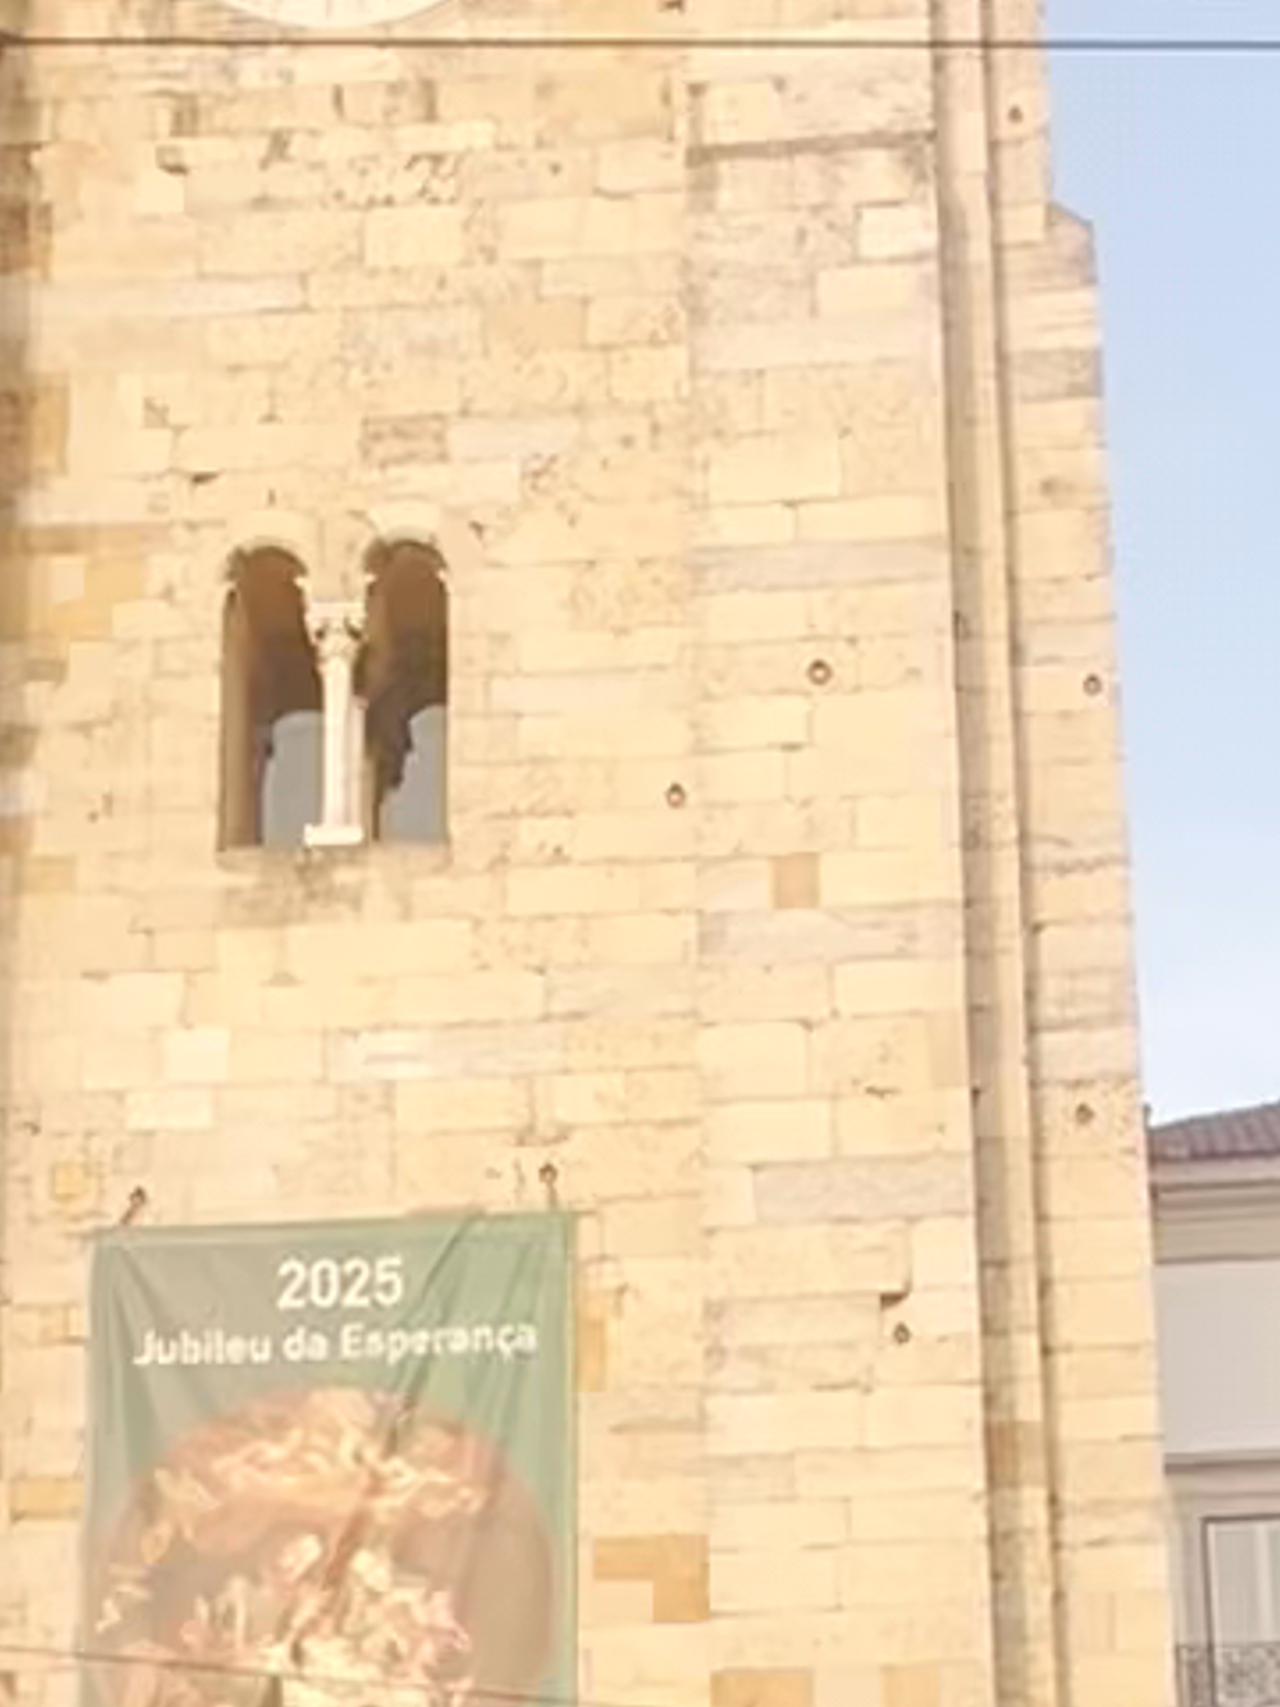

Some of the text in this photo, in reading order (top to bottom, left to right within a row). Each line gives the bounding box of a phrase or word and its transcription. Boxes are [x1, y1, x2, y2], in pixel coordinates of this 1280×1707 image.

[276, 1257, 405, 1310] 2025
[132, 1321, 540, 1366] Jubileu da Esperança
